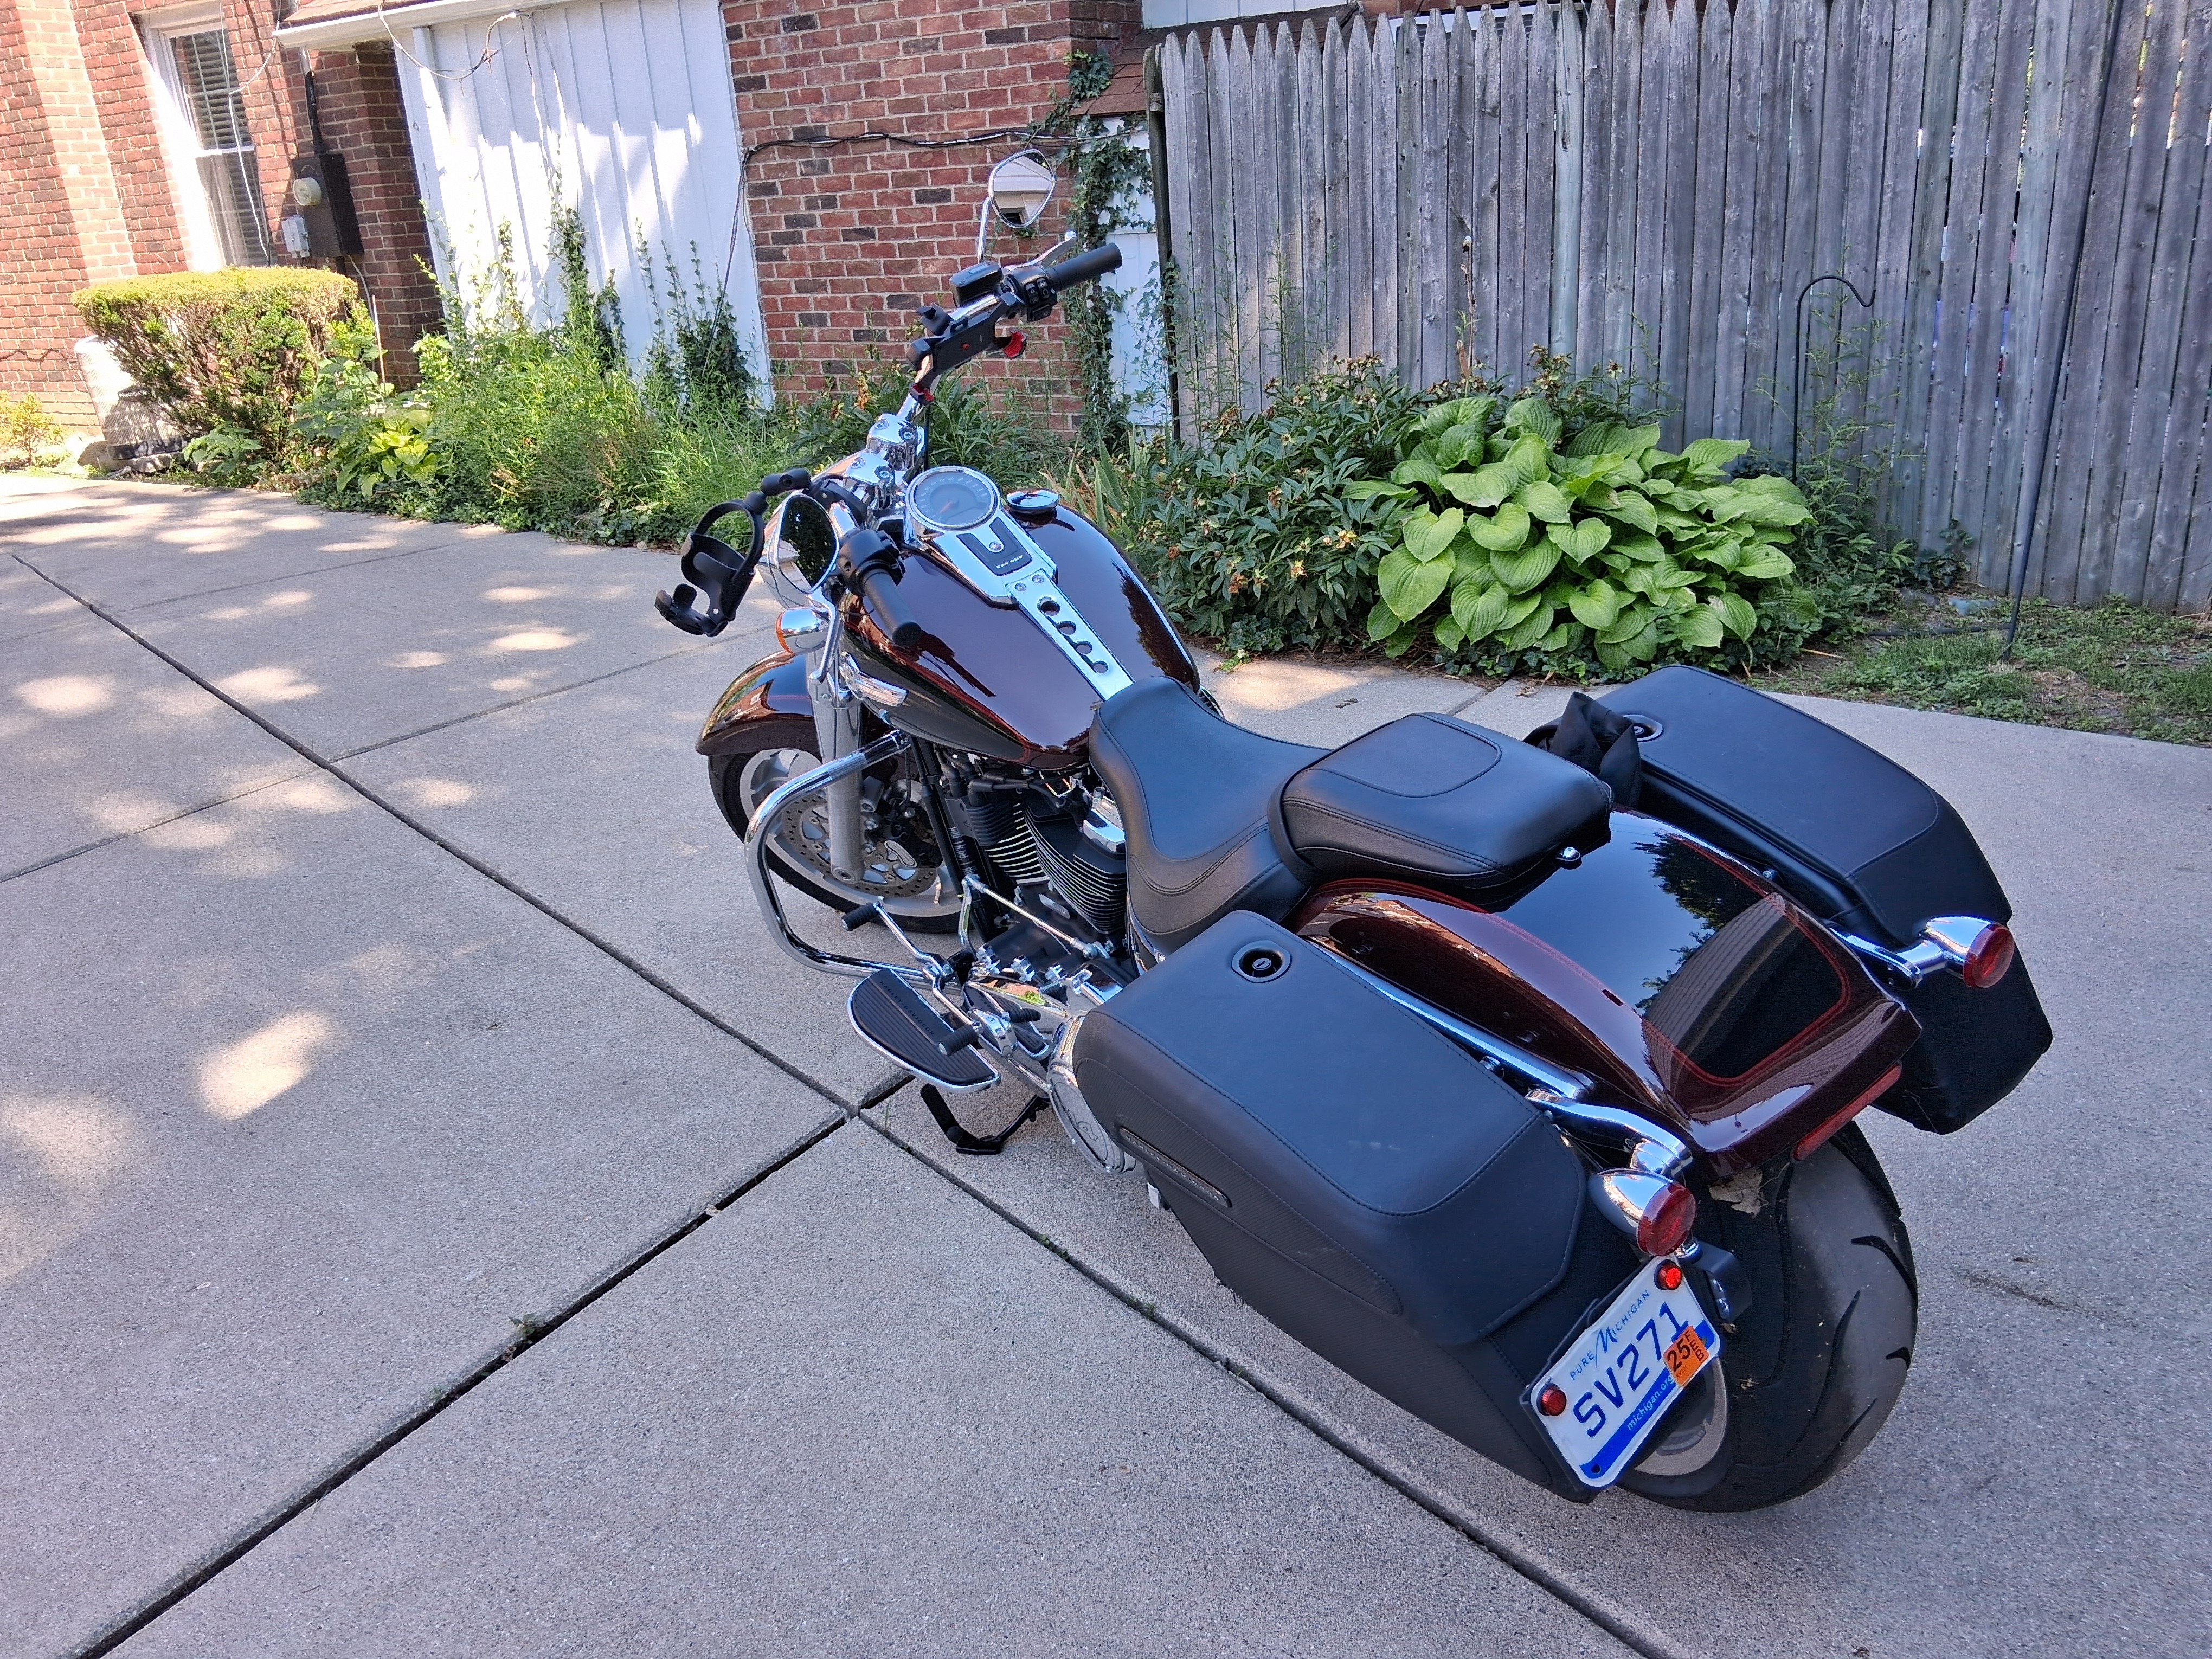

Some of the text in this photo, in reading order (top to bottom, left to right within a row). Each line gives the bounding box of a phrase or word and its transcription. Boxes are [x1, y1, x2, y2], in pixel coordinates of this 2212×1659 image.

[118, 390, 149, 398] FRIGIDAR
[1667, 1338, 1692, 1372] 25
[1684, 1329, 1705, 1361] FEB
[1570, 1350, 1594, 1380] PURE
[1573, 1302, 1689, 1438] SV271
[1626, 1373, 1674, 1431] michigan.org
